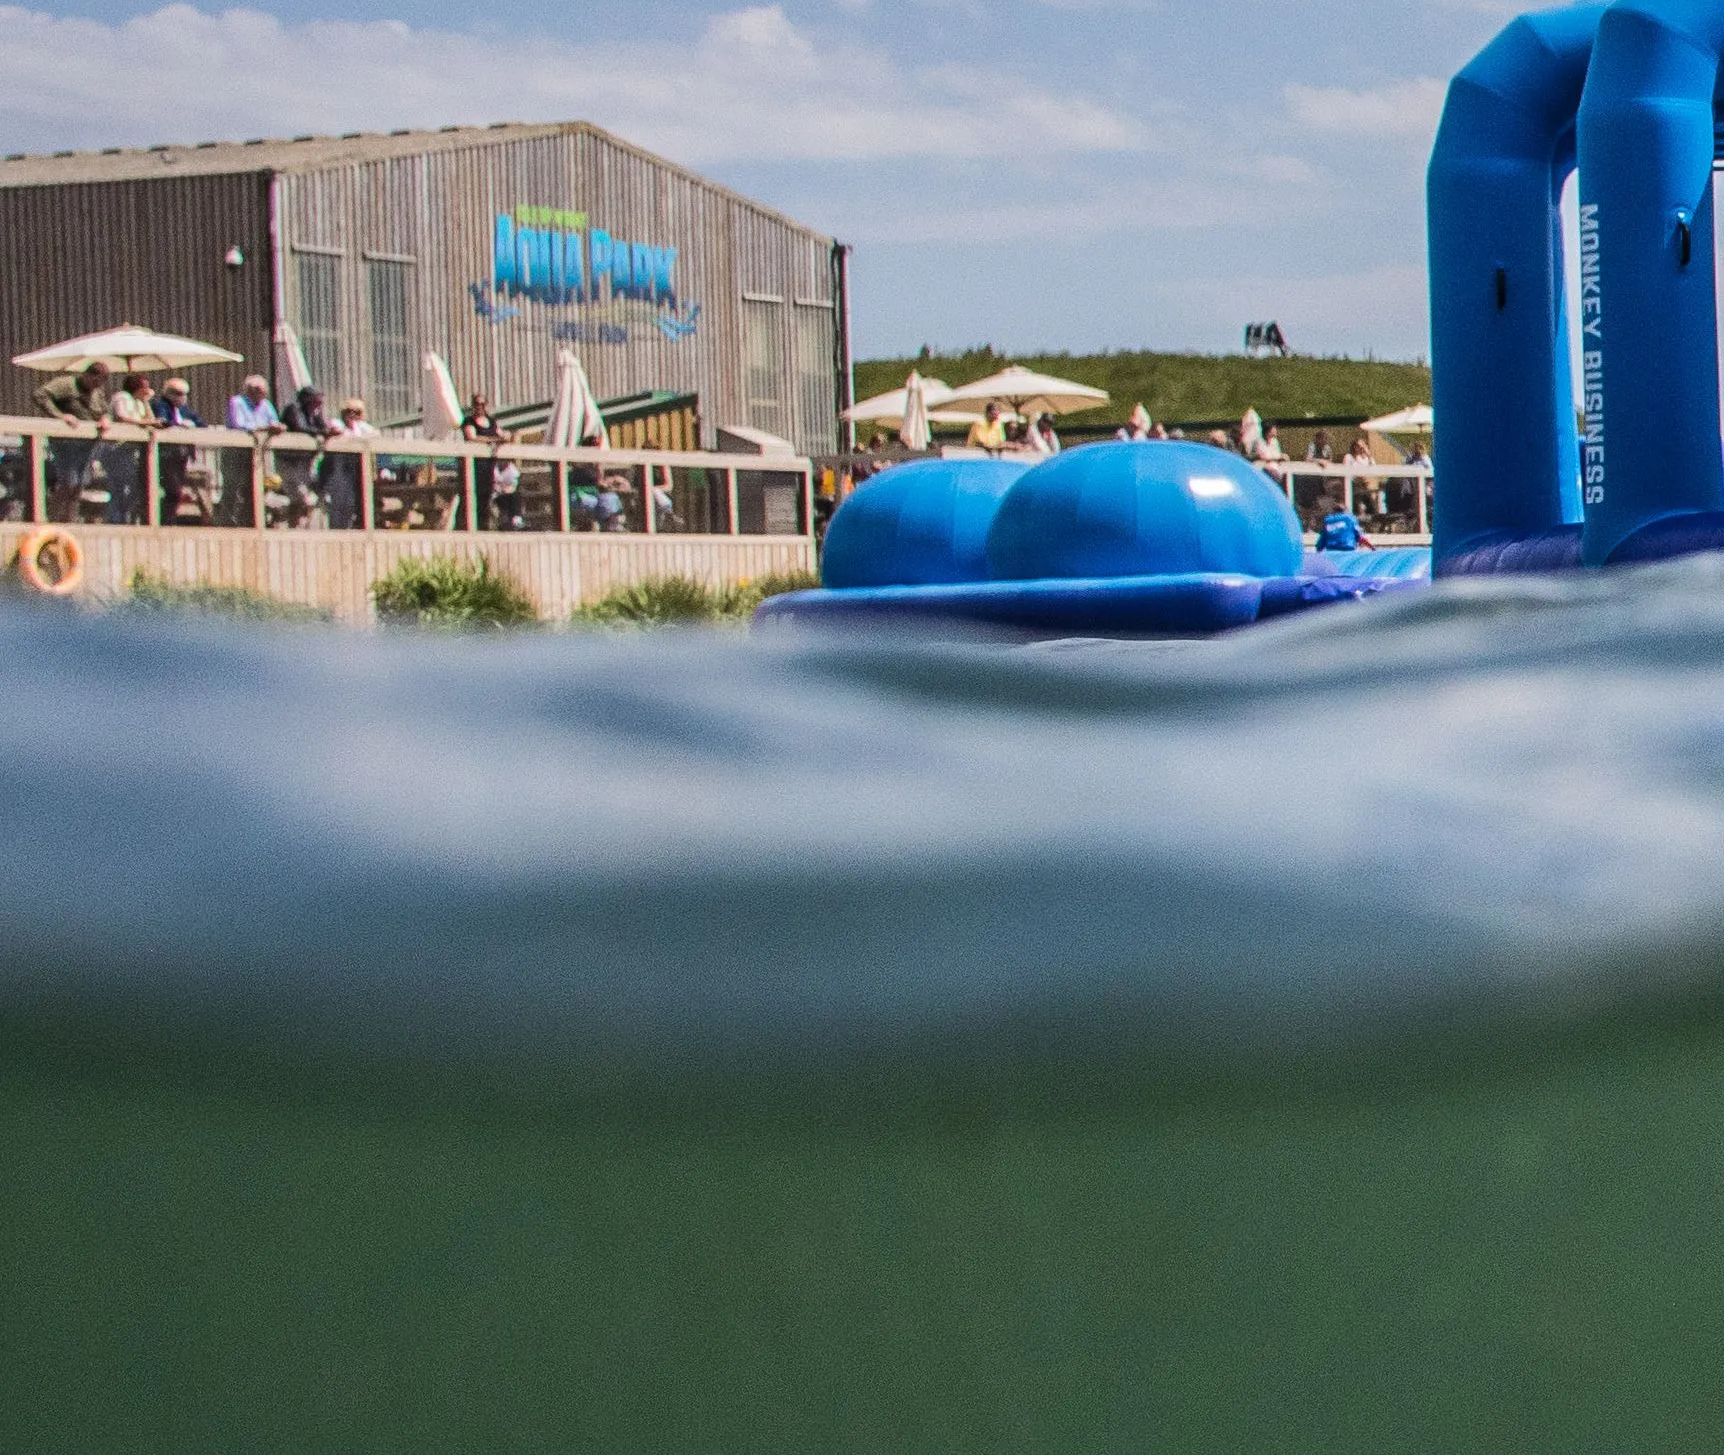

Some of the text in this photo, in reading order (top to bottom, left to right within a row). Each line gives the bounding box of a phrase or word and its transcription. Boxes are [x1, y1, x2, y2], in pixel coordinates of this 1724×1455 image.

[495, 213, 679, 311] AQUA PARK
[1580, 203, 1605, 505] MONKEY BUSINESS
